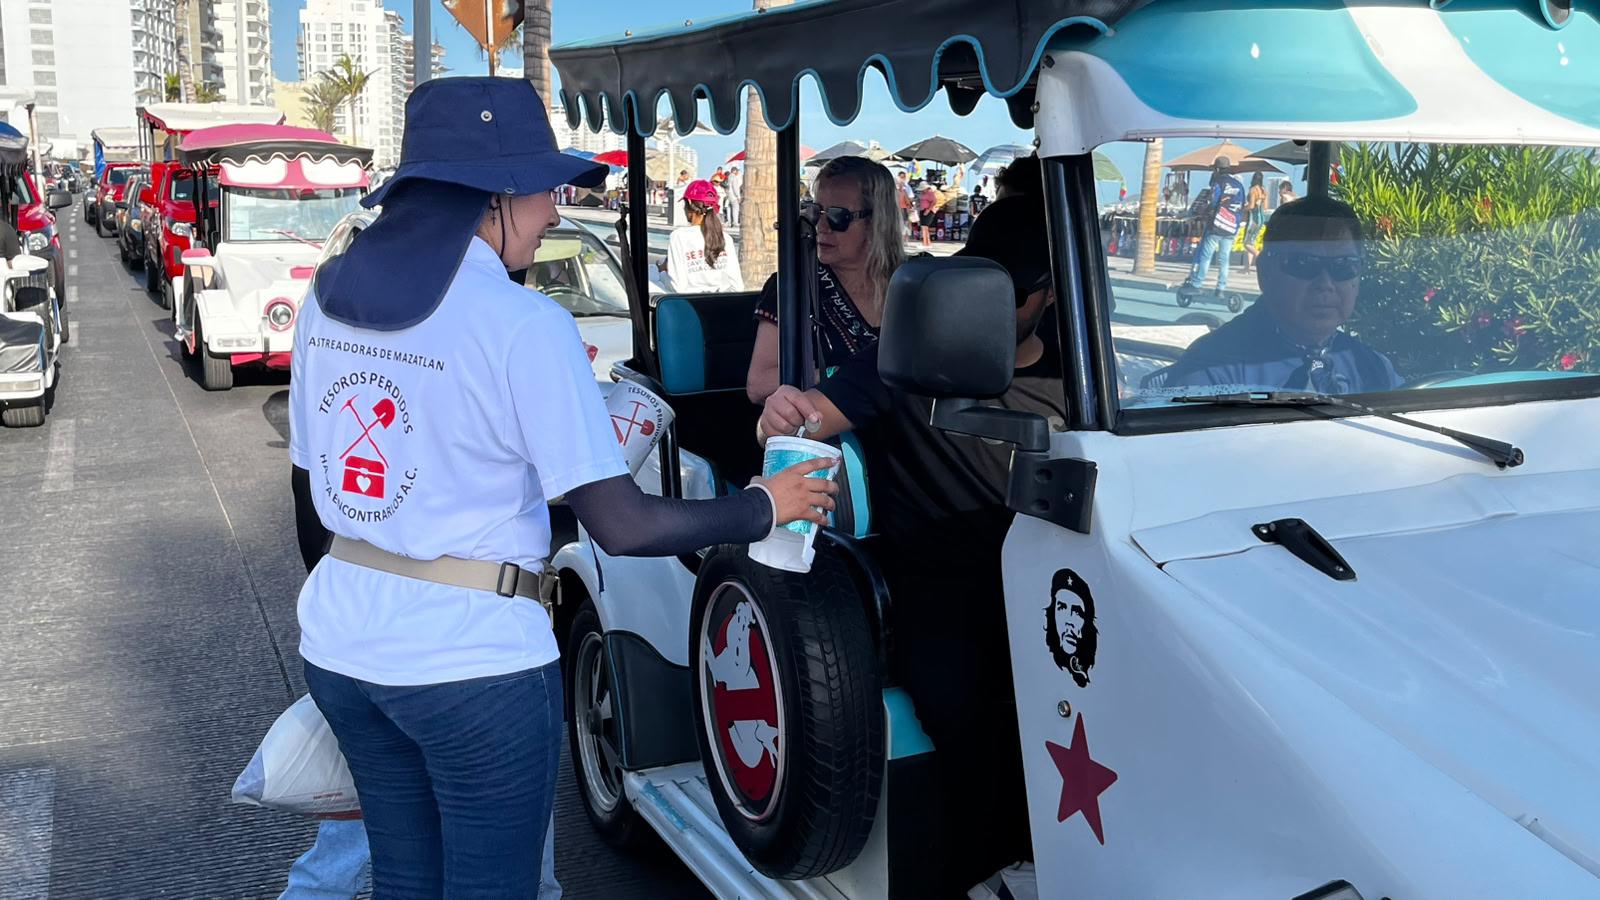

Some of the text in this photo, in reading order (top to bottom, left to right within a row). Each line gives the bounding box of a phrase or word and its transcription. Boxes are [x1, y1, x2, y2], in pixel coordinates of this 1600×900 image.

[831, 291, 856, 319] KARL
[379, 348, 392, 360] DE
[393, 350, 445, 372] MAZATLAN
[318, 371, 414, 435] TESOROS PERDIDOS
[400, 466, 418, 496] A.C.
